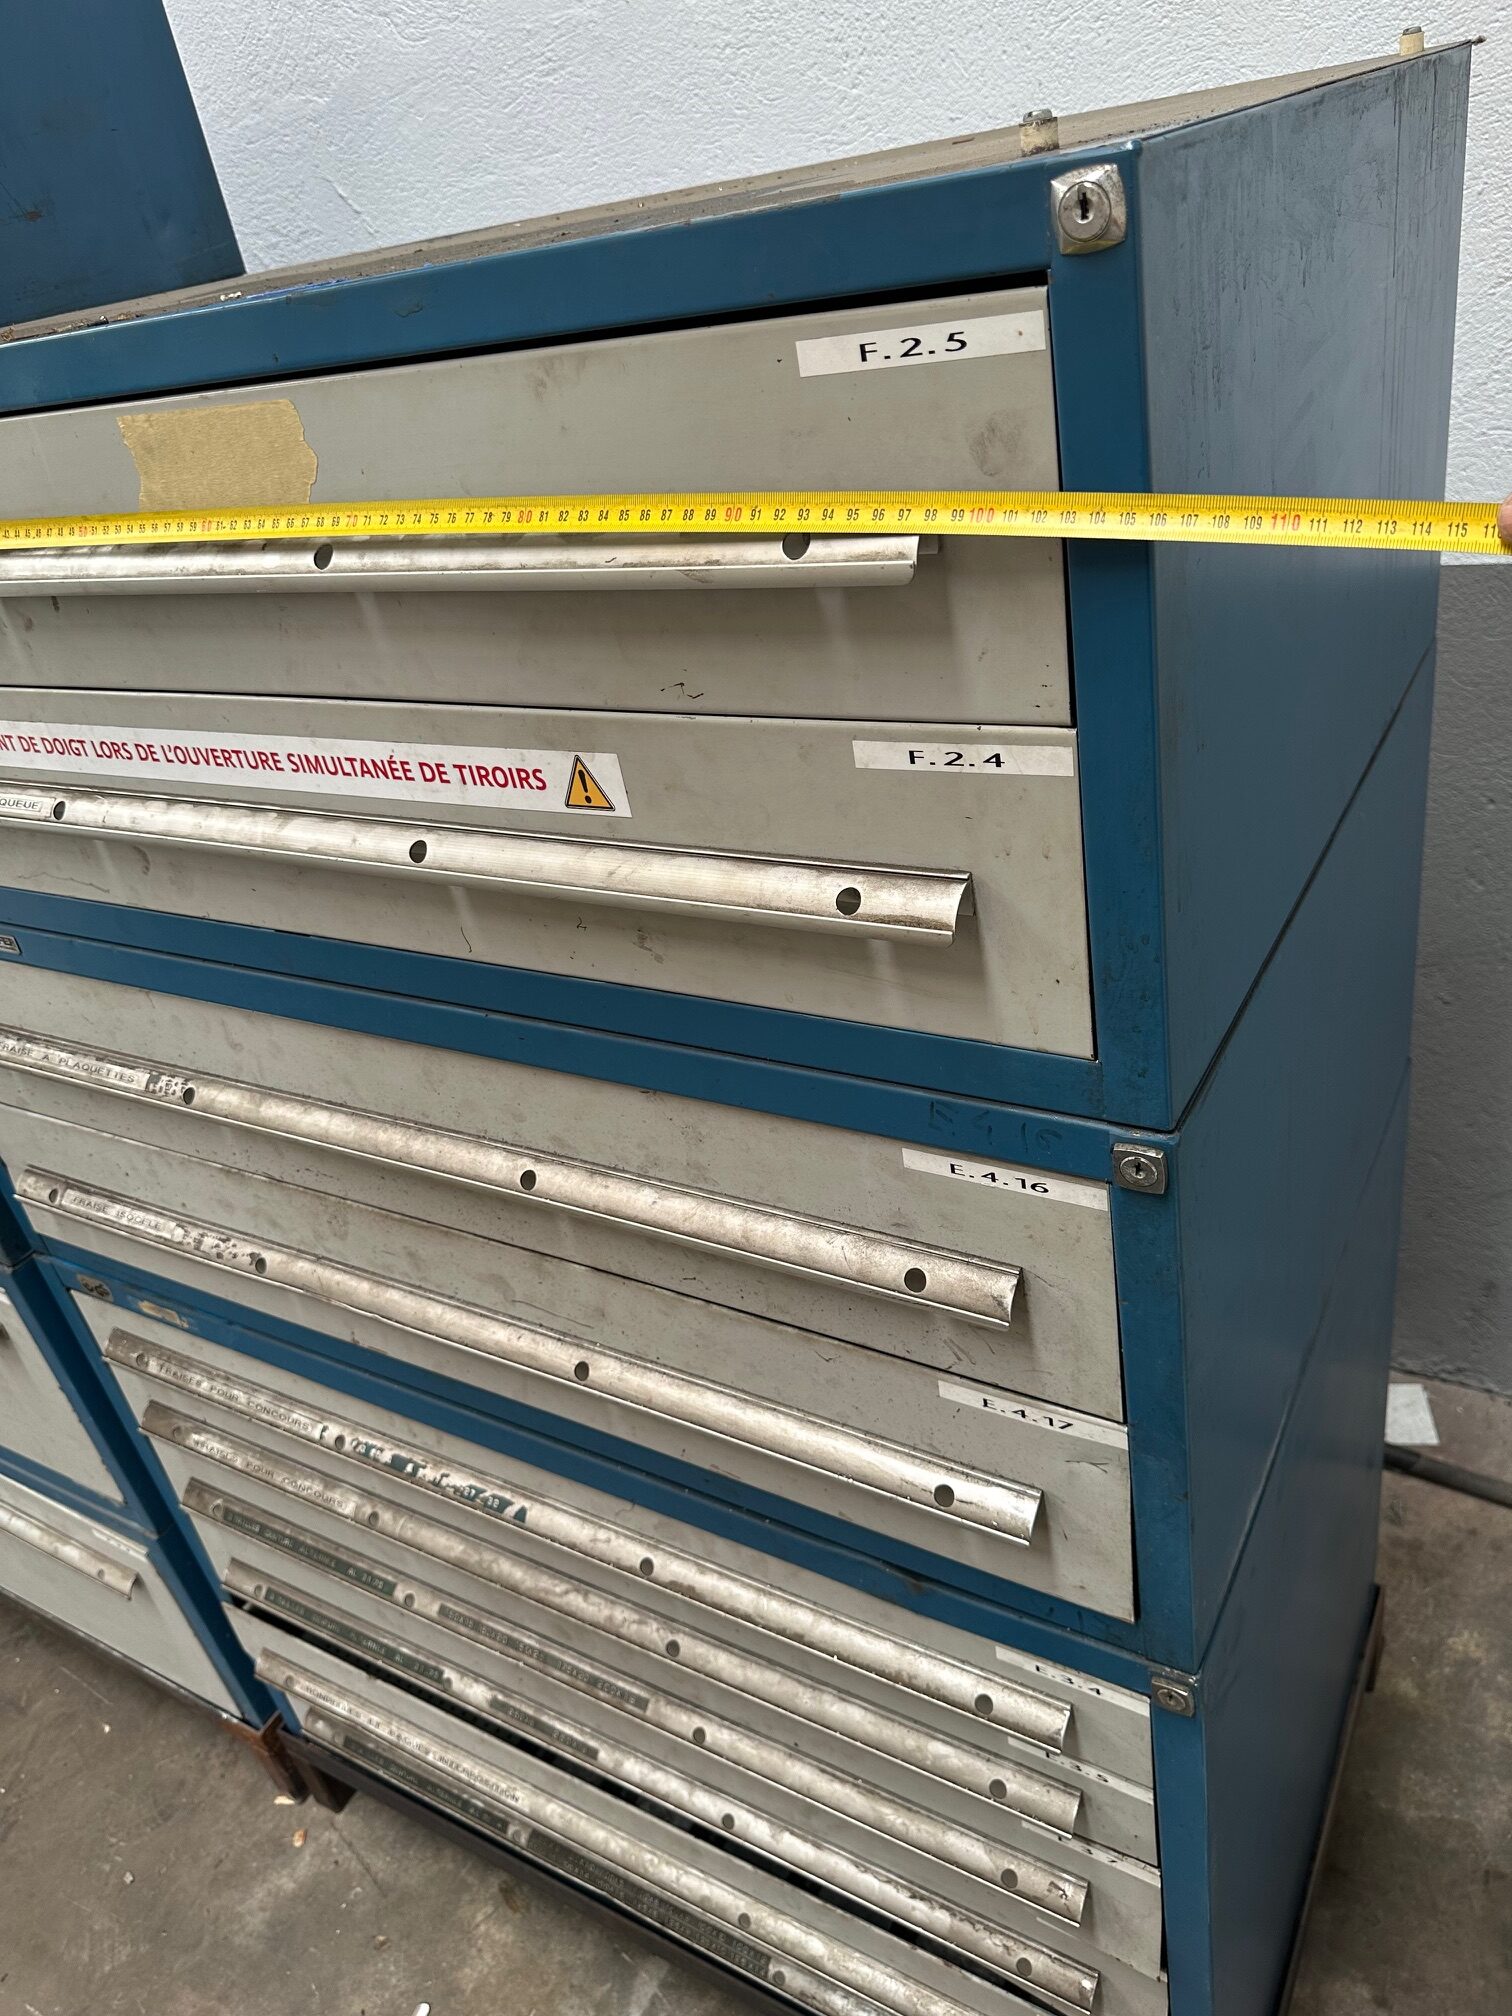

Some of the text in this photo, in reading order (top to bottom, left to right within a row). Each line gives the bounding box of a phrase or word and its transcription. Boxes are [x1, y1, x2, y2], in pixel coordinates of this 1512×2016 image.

[859, 331, 968, 362] F.2.5
[229, 520, 238, 530] 62
[243, 519, 252, 530] 63
[257, 518, 266, 529] 64
[272, 518, 280, 528] 65
[286, 517, 295, 528] 66
[301, 517, 310, 528] 67
[315, 516, 325, 527] 68
[331, 516, 341, 527] 69
[345, 514, 358, 527] 70
[362, 515, 372, 526] 71
[379, 514, 389, 525] 72
[396, 514, 405, 525] 73
[412, 513, 422, 524] 74
[430, 513, 439, 524] 75
[447, 512, 457, 524] 76
[464, 512, 475, 523] 77
[483, 511, 494, 523] 78
[501, 511, 512, 522] 79
[517, 510, 532, 523] 80
[538, 510, 549, 522] 81
[558, 510, 570, 522] 82
[578, 510, 589, 522] 83
[597, 510, 610, 522] 84
[618, 510, 631, 521] 85
[639, 509, 652, 521] 86
[660, 509, 673, 521] 87
[682, 509, 695, 521] 88
[704, 509, 717, 521] 89
[725, 508, 742, 521] 90
[749, 508, 762, 521] 91
[773, 508, 787, 520] 92
[797, 508, 811, 521] 93
[821, 508, 835, 521] 94
[846, 508, 860, 521] 95
[872, 508, 886, 521] 96
[898, 508, 912, 521] 97
[923, 508, 938, 522] 98
[950, 508, 965, 522] 99
[969, 508, 995, 523] 100
[1002, 509, 1018, 522] 101
[1031, 509, 1047, 523] 102
[1059, 510, 1077, 524] 103
[1088, 511, 1106, 525] 104
[1119, 512, 1137, 526] 105
[1149, 513, 1168, 527] 106
[1181, 514, 1199, 527] 107
[1212, 515, 1231, 529] 108
[1243, 516, 1263, 530] 109
[1271, 514, 1301, 531] 110
[1309, 518, 1328, 532] 111
[1343, 519, 1363, 534] 112
[1378, 520, 1398, 535] 113
[1412, 521, 1433, 536] 114
[1448, 522, 1468, 537] 115
[17, 735, 42, 754] DE
[41, 737, 90, 757] DOIGT
[90, 740, 134, 761] LORS
[135, 743, 159, 763] DE
[286, 752, 416, 782] SIMULTANÉE
[418, 762, 452, 785] DE
[453, 764, 548, 791] TIROIRS
[908, 750, 1006, 768] F.2.4
[58, 1058, 135, 1084] PLAQUETTES
[950, 1162, 1050, 1194] E.4.16
[982, 1398, 1074, 1430] E.4.17
